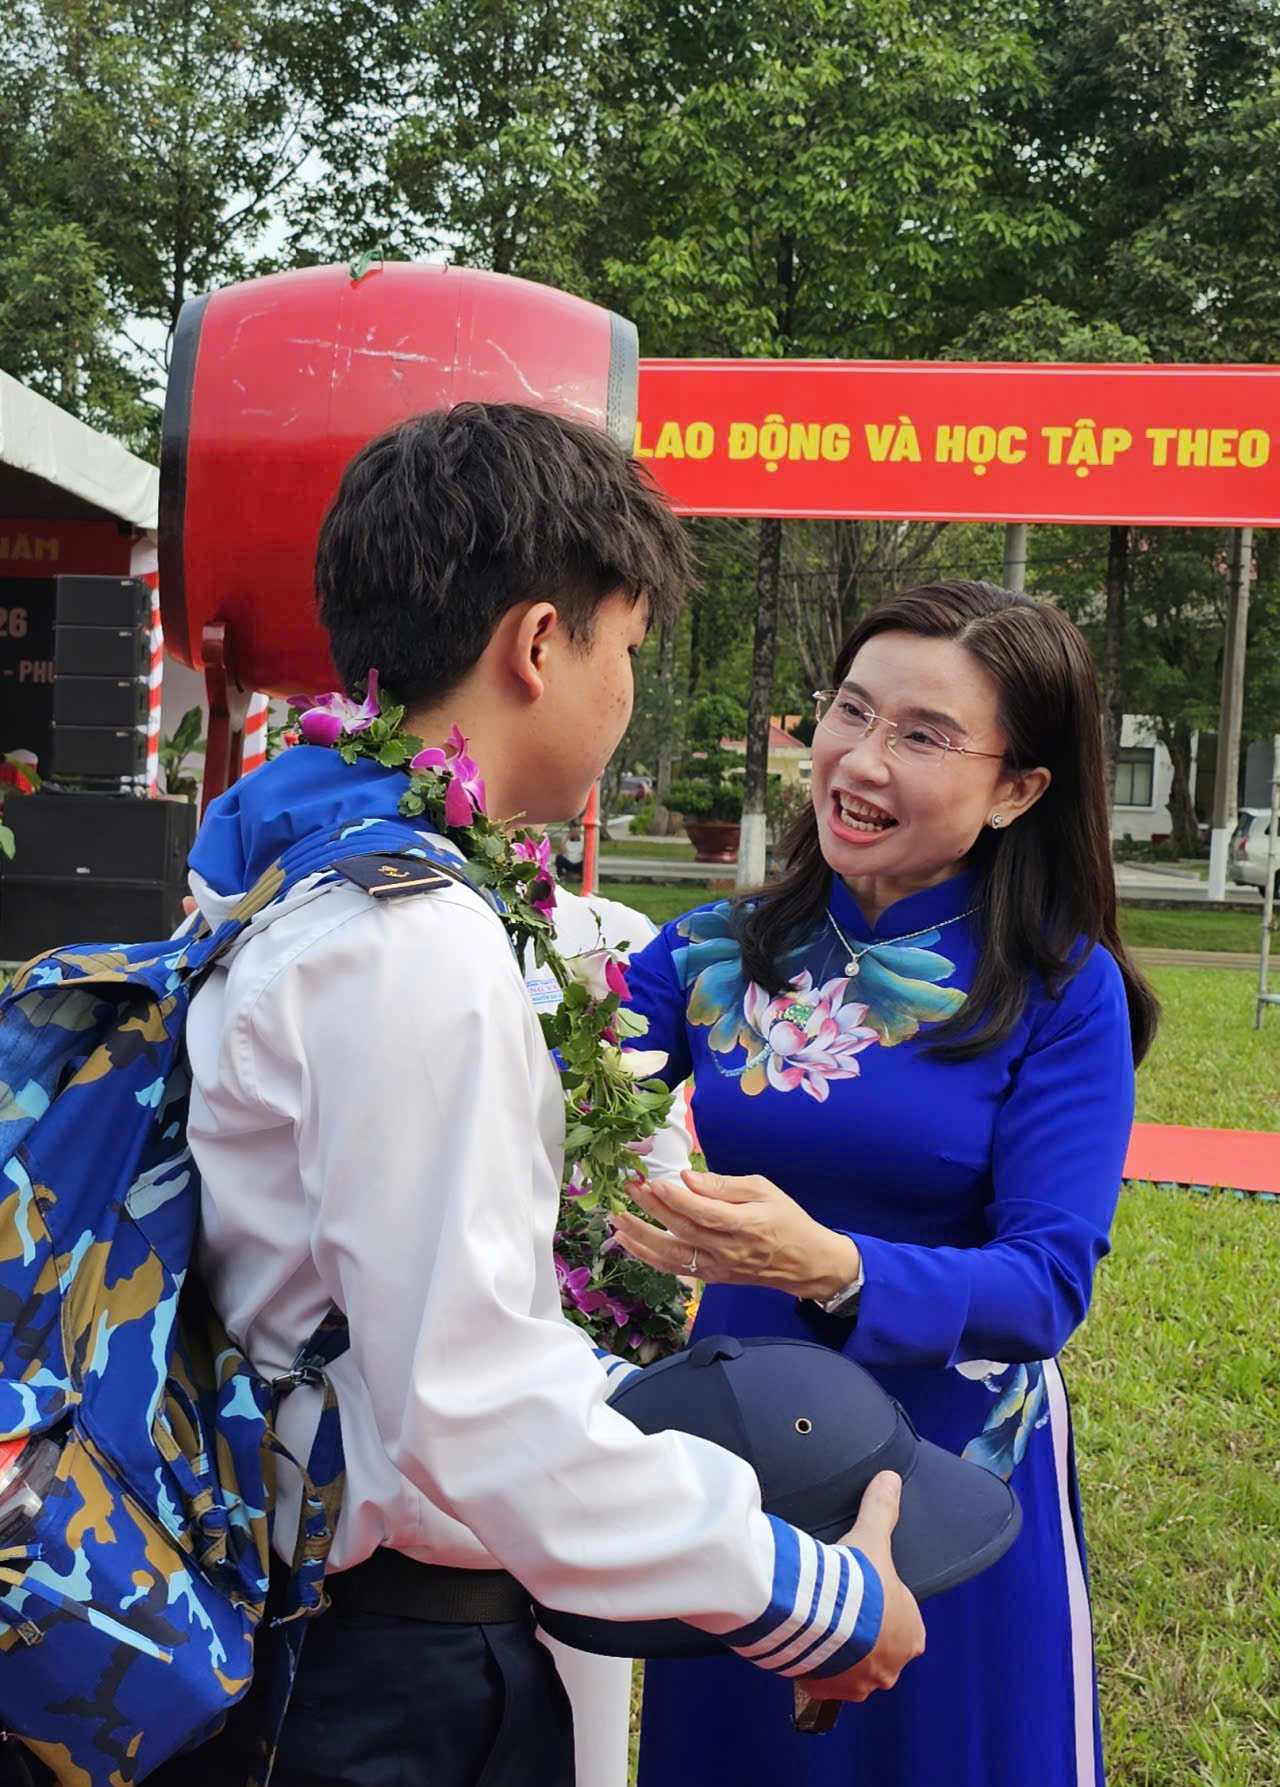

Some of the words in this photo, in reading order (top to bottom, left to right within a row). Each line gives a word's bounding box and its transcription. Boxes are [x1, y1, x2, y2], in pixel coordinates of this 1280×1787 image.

[632, 421, 715, 459] LAO
[728, 413, 851, 473] ĐỘNG
[864, 416, 922, 463] VÀ
[935, 425, 1028, 476] HỌC
[1041, 418, 1133, 478] TẬP
[1145, 428, 1271, 468] THEO
